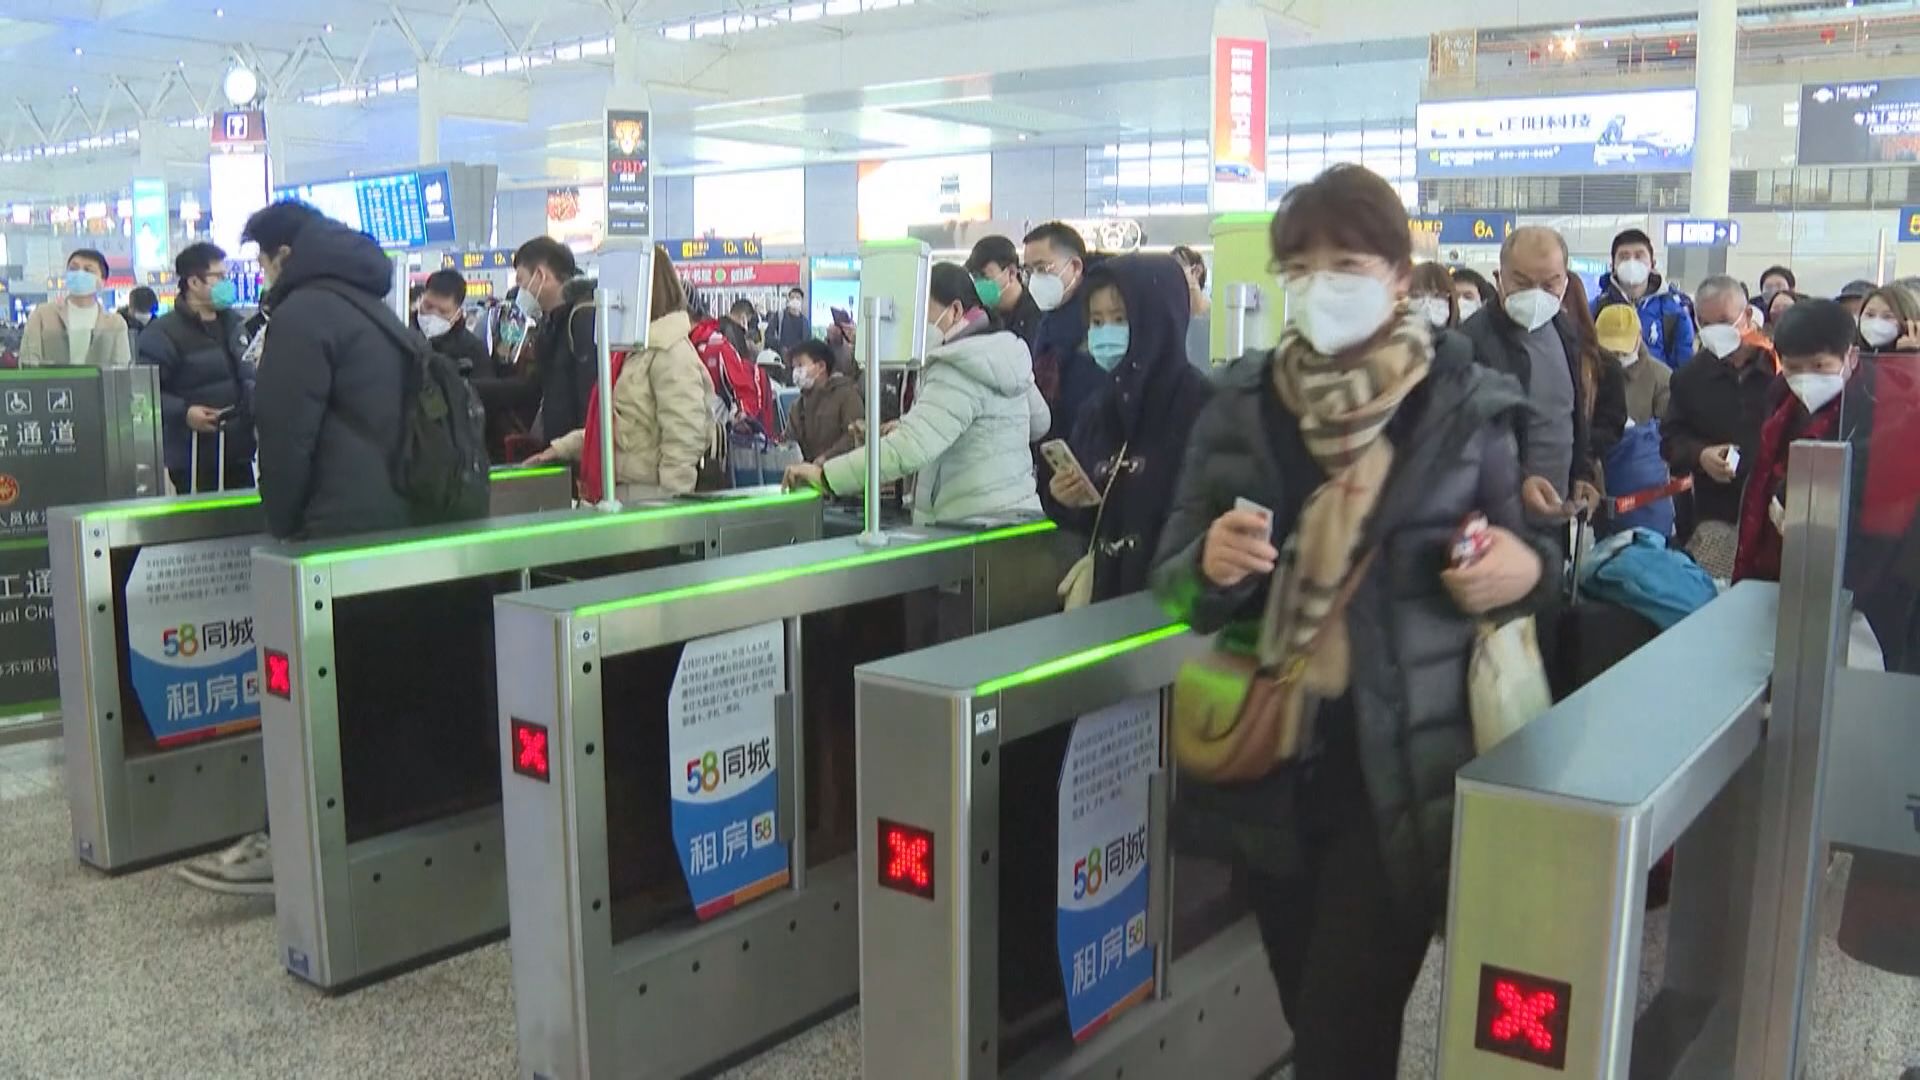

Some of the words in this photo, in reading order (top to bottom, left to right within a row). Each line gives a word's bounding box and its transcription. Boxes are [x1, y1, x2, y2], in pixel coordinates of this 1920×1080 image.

[723, 241, 738, 256] 10A
[743, 241, 759, 256] 10A
[1474, 219, 1494, 239] 6A
[163, 616, 255, 658] 58同城
[166, 673, 240, 722] 租房
[686, 736, 771, 796] 58同城
[689, 819, 749, 876] 租房
[755, 815, 773, 842] 58
[1073, 824, 1146, 900] 58同城
[1071, 926, 1124, 997] 租房
[1128, 917, 1144, 949] 58
